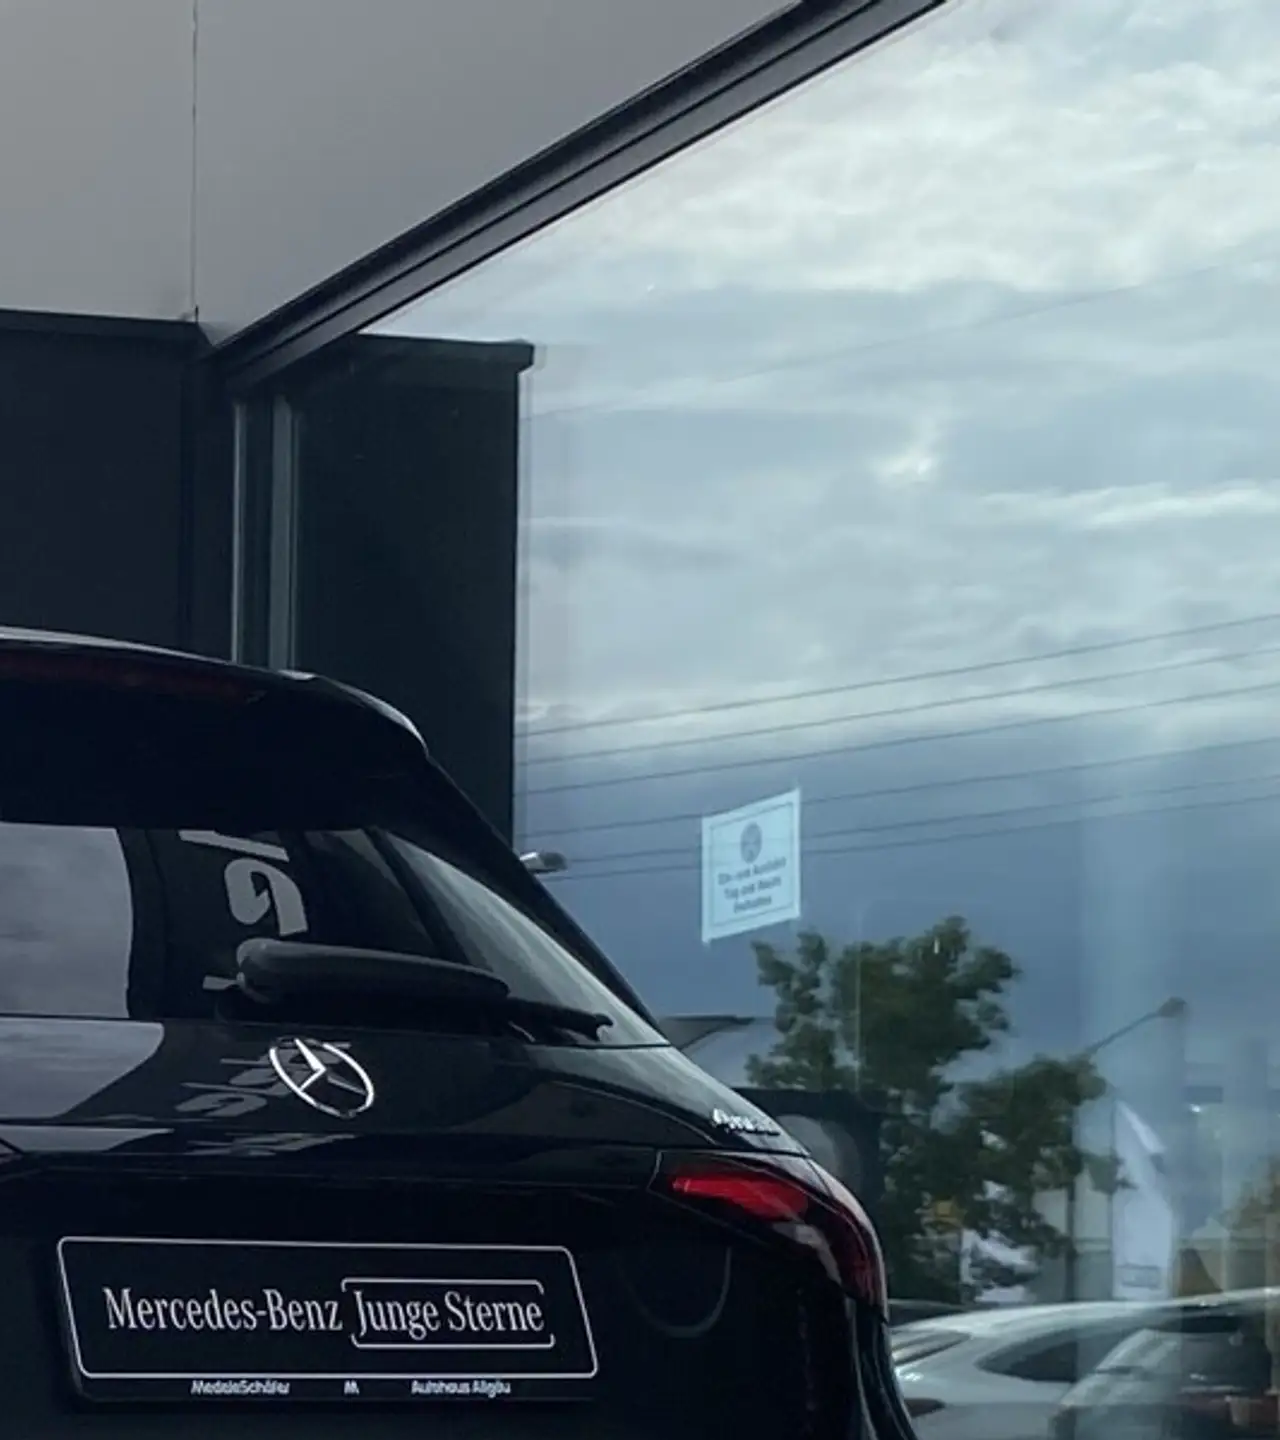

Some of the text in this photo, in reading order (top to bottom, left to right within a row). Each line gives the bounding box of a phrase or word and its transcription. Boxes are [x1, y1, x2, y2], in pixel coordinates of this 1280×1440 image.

[103, 1284, 545, 1341] Mercedes-Benz Junge Sterne
